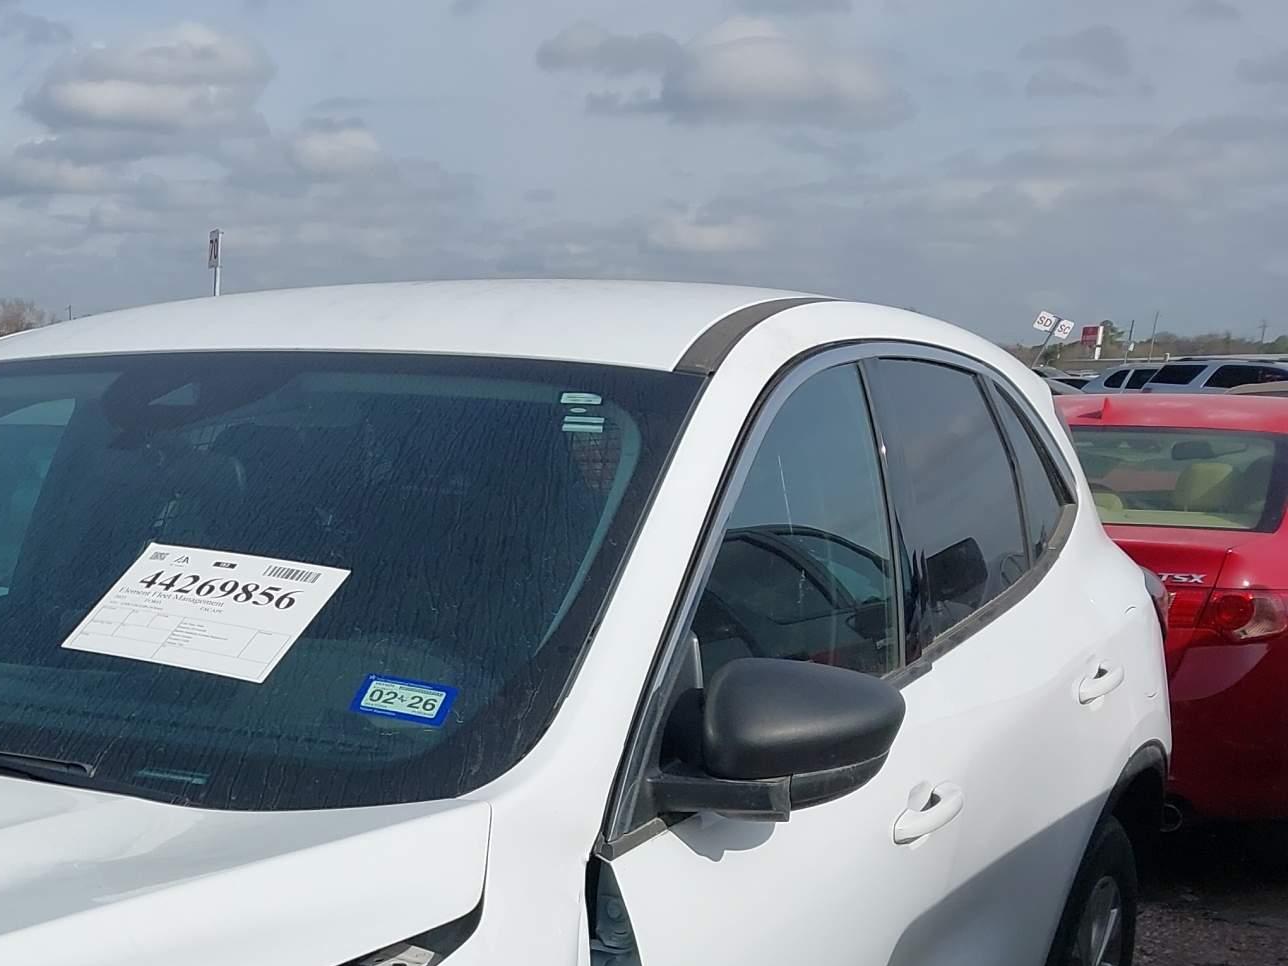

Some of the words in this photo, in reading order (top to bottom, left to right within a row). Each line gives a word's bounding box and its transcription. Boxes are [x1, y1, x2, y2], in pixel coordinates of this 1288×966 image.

[1037, 315, 1052, 328] SD
[1057, 323, 1071, 335] SC
[1158, 572, 1208, 584] TSX
[139, 570, 304, 610] 44269856
[174, 593, 225, 608] Management
[369, 688, 398, 705] 02
[406, 695, 438, 712] 26
